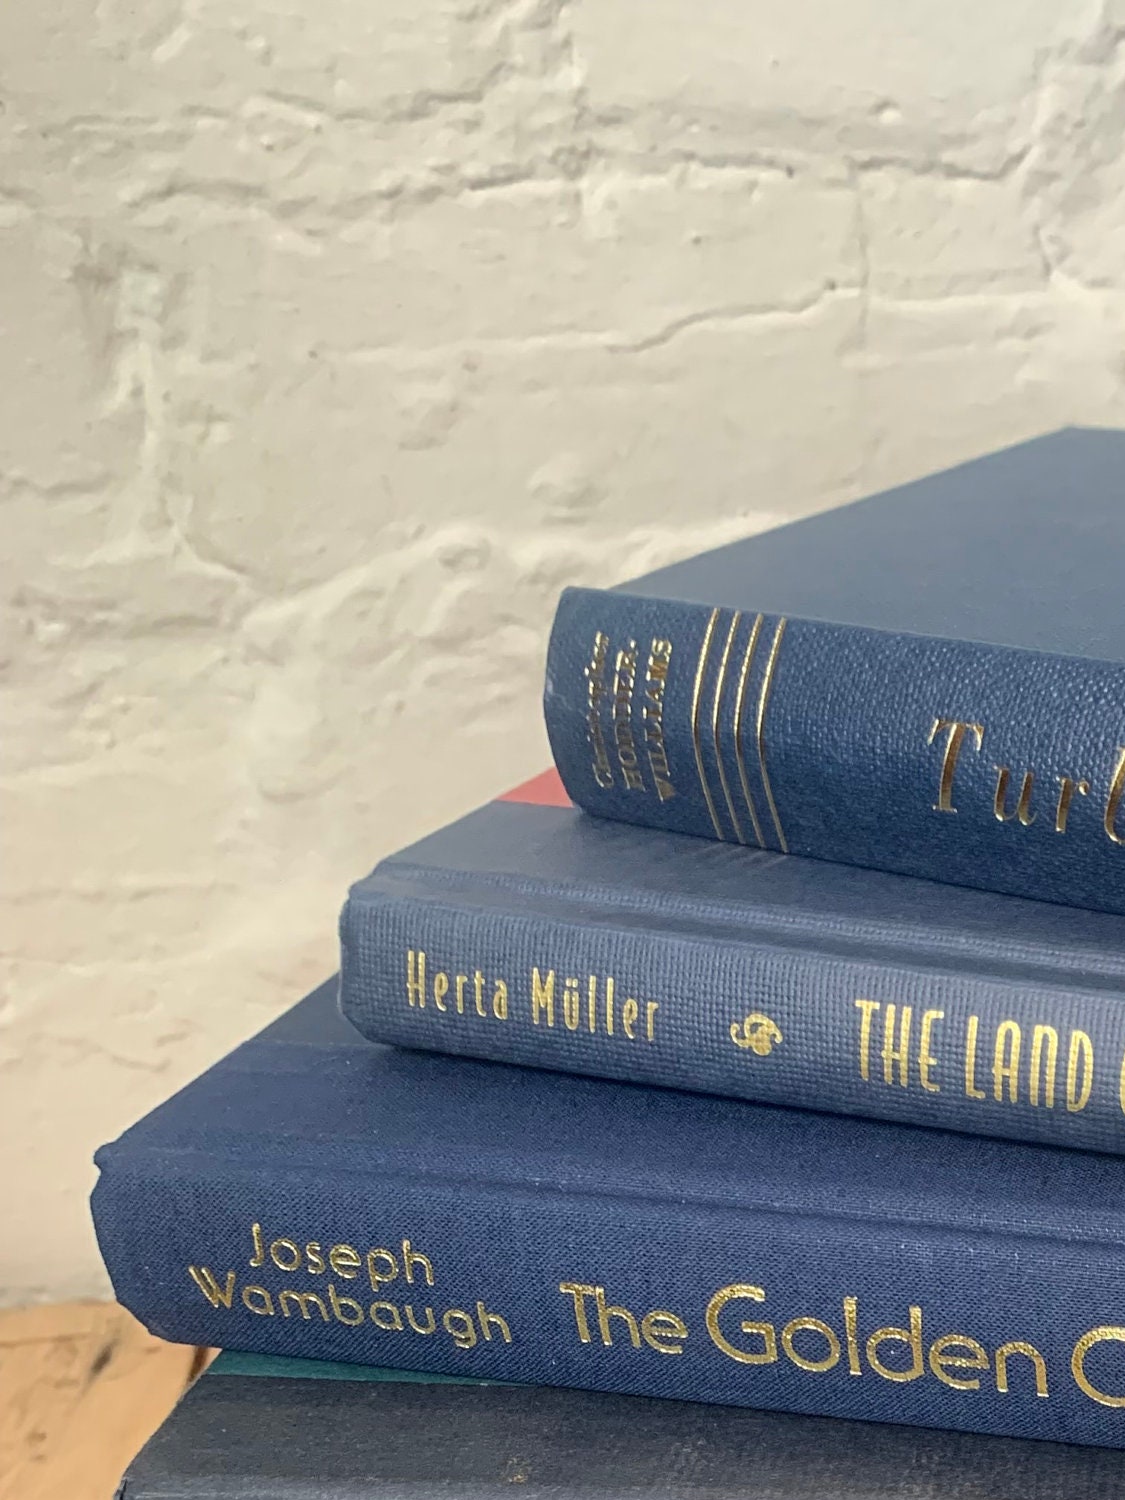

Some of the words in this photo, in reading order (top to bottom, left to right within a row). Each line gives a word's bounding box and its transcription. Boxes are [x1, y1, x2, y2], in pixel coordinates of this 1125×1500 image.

[642, 637, 677, 803] WILLIAMS
[406, 949, 508, 1021] Herta
[531, 966, 660, 1042] Müller
[854, 998, 945, 1093] THE
[964, 1014, 1095, 1113] LAND
[188, 1263, 513, 1350] Wambaugh
[248, 1222, 435, 1293] Joseph
[559, 1280, 689, 1356] The
[704, 1282, 1051, 1399] Golden
